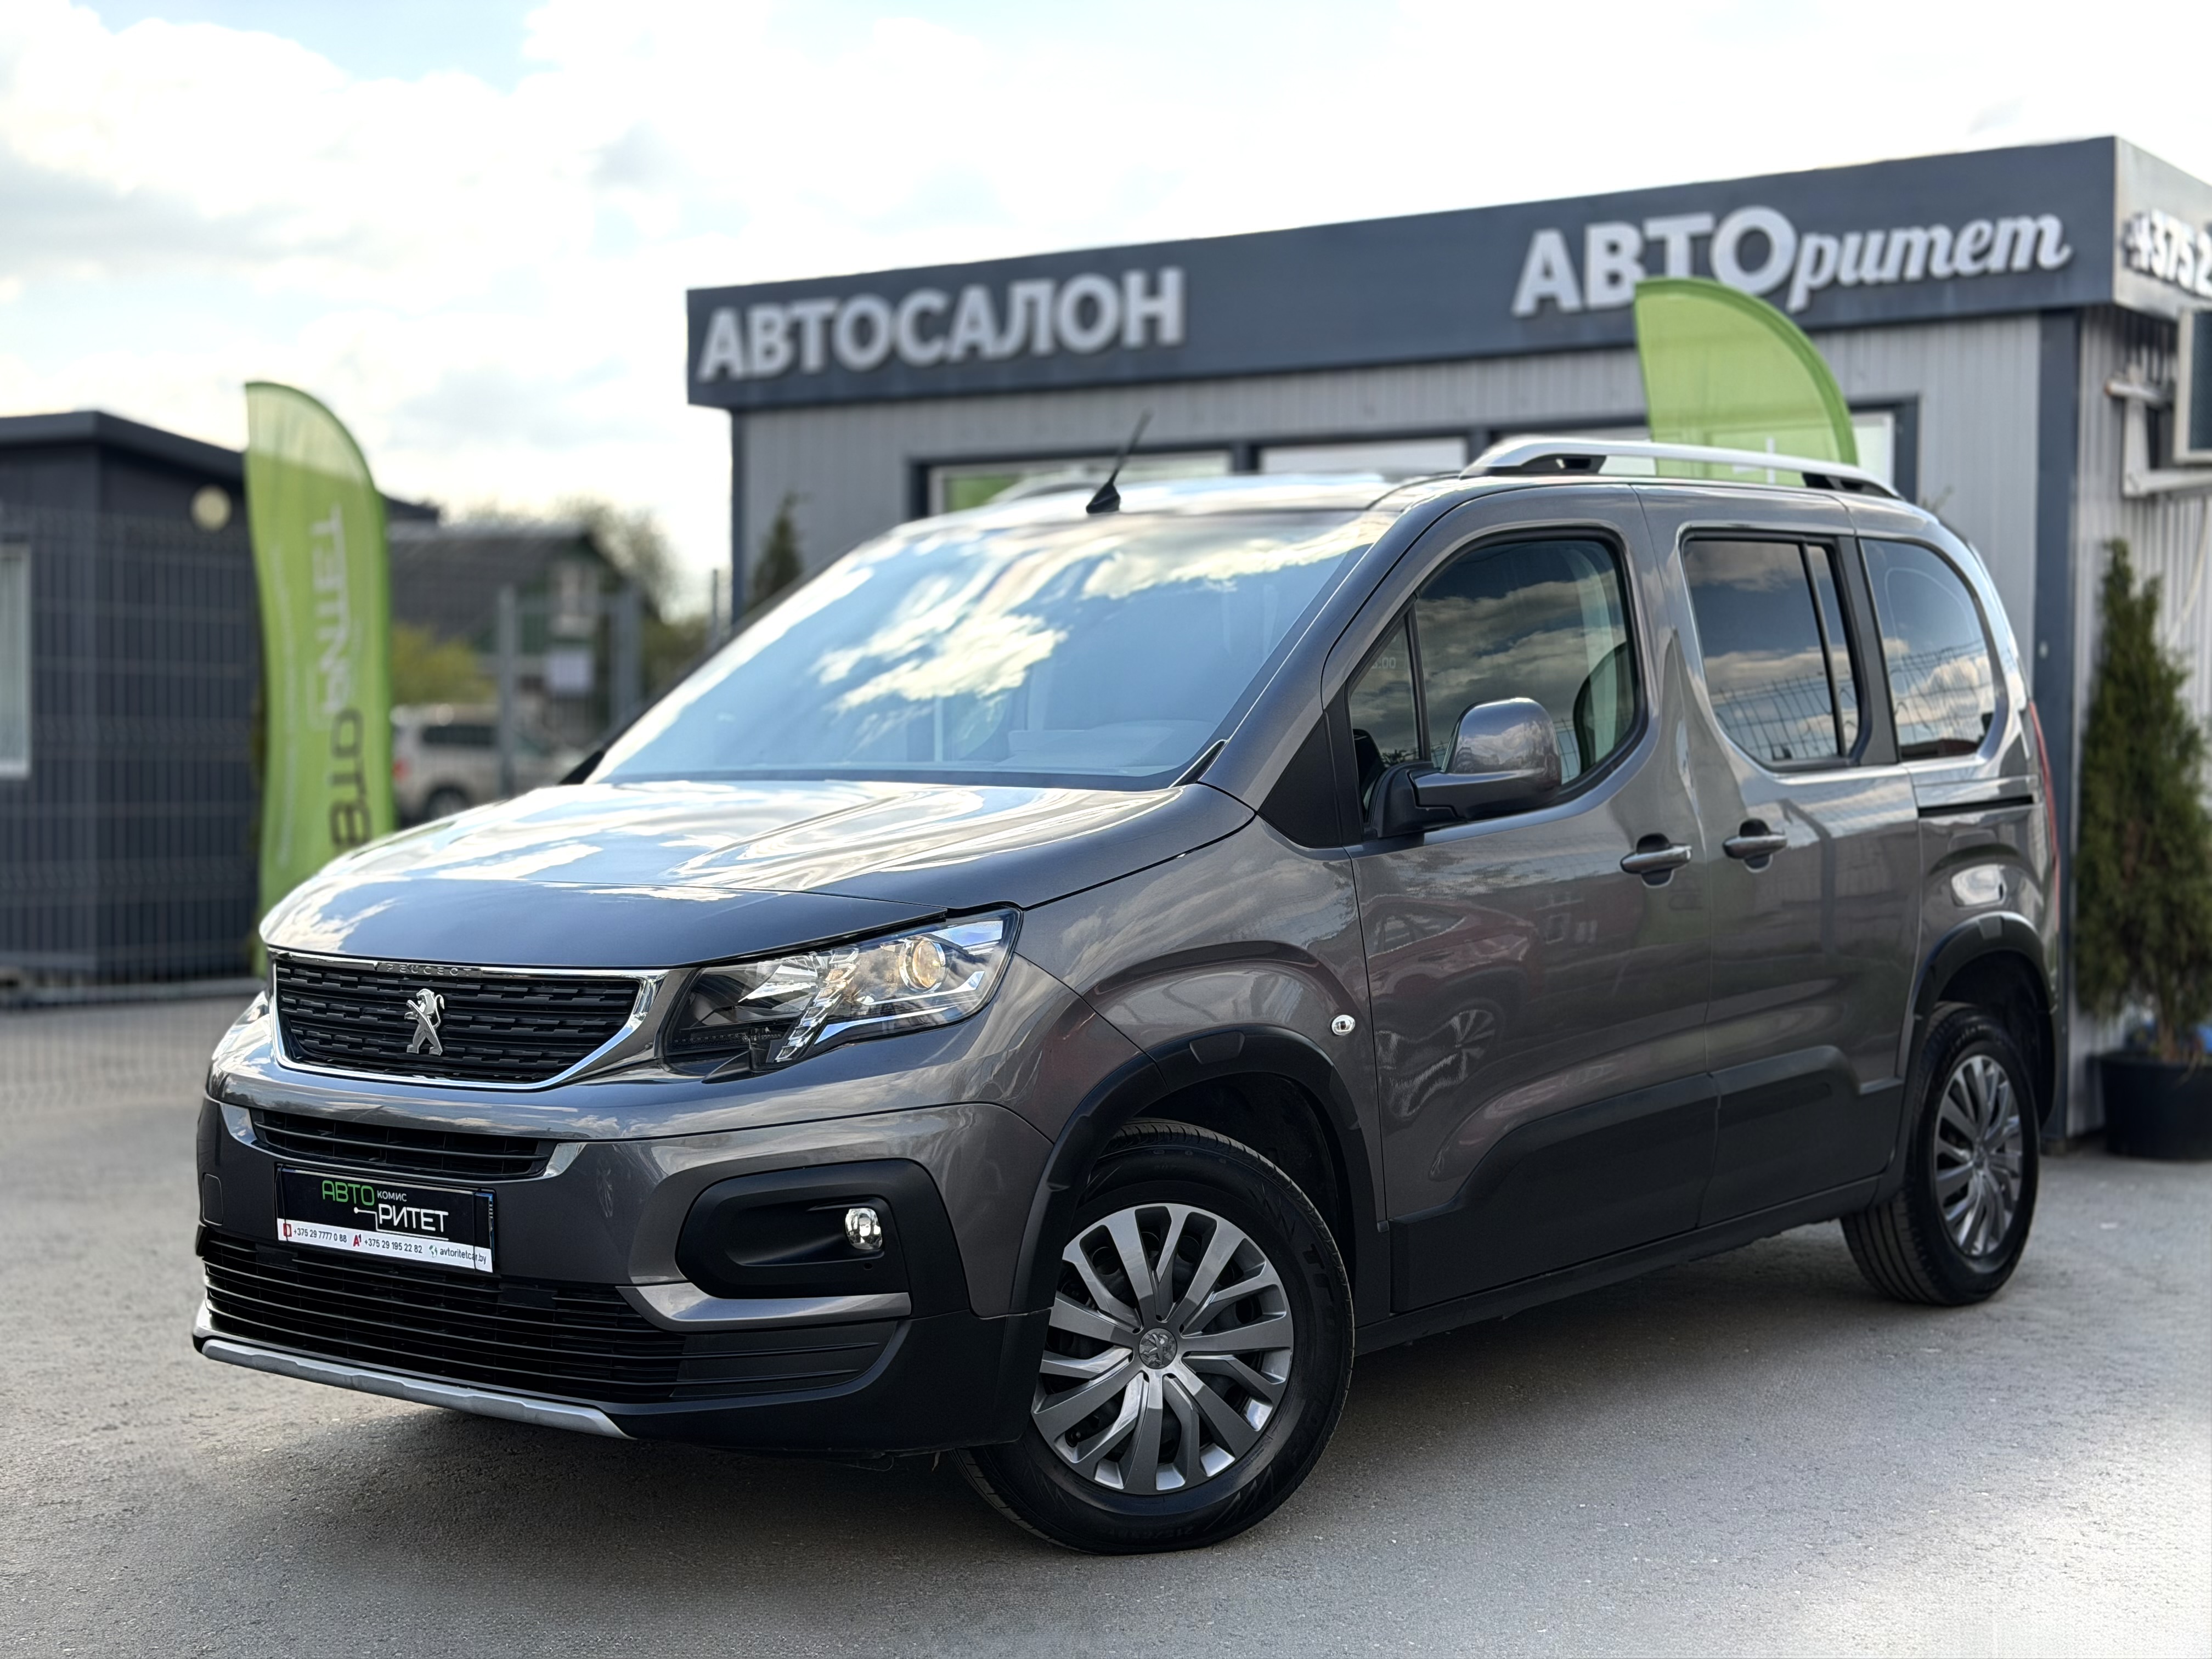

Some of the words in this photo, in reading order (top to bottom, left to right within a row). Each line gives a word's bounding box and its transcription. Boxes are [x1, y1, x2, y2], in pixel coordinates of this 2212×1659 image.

[697, 267, 1184, 383] АВТОСАЛОН
[387, 964, 471, 976] PEUGEOT
[322, 1180, 375, 1206] АВТО
[377, 1190, 407, 1202] КОМИС
[378, 1204, 449, 1232] РИТЕТ
[294, 1227, 308, 1237] +375
[310, 1229, 317, 1238] 29
[318, 1231, 332, 1240] 7777
[334, 1233, 338, 1242] 0
[339, 1234, 347, 1243] 88
[364, 1238, 380, 1248] +375
[382, 1240, 390, 1249] 29
[392, 1242, 402, 1251] 195
[404, 1243, 412, 1252] 22
[414, 1245, 423, 1254] 82
[439, 1248, 487, 1265] avtoritetcar.by
